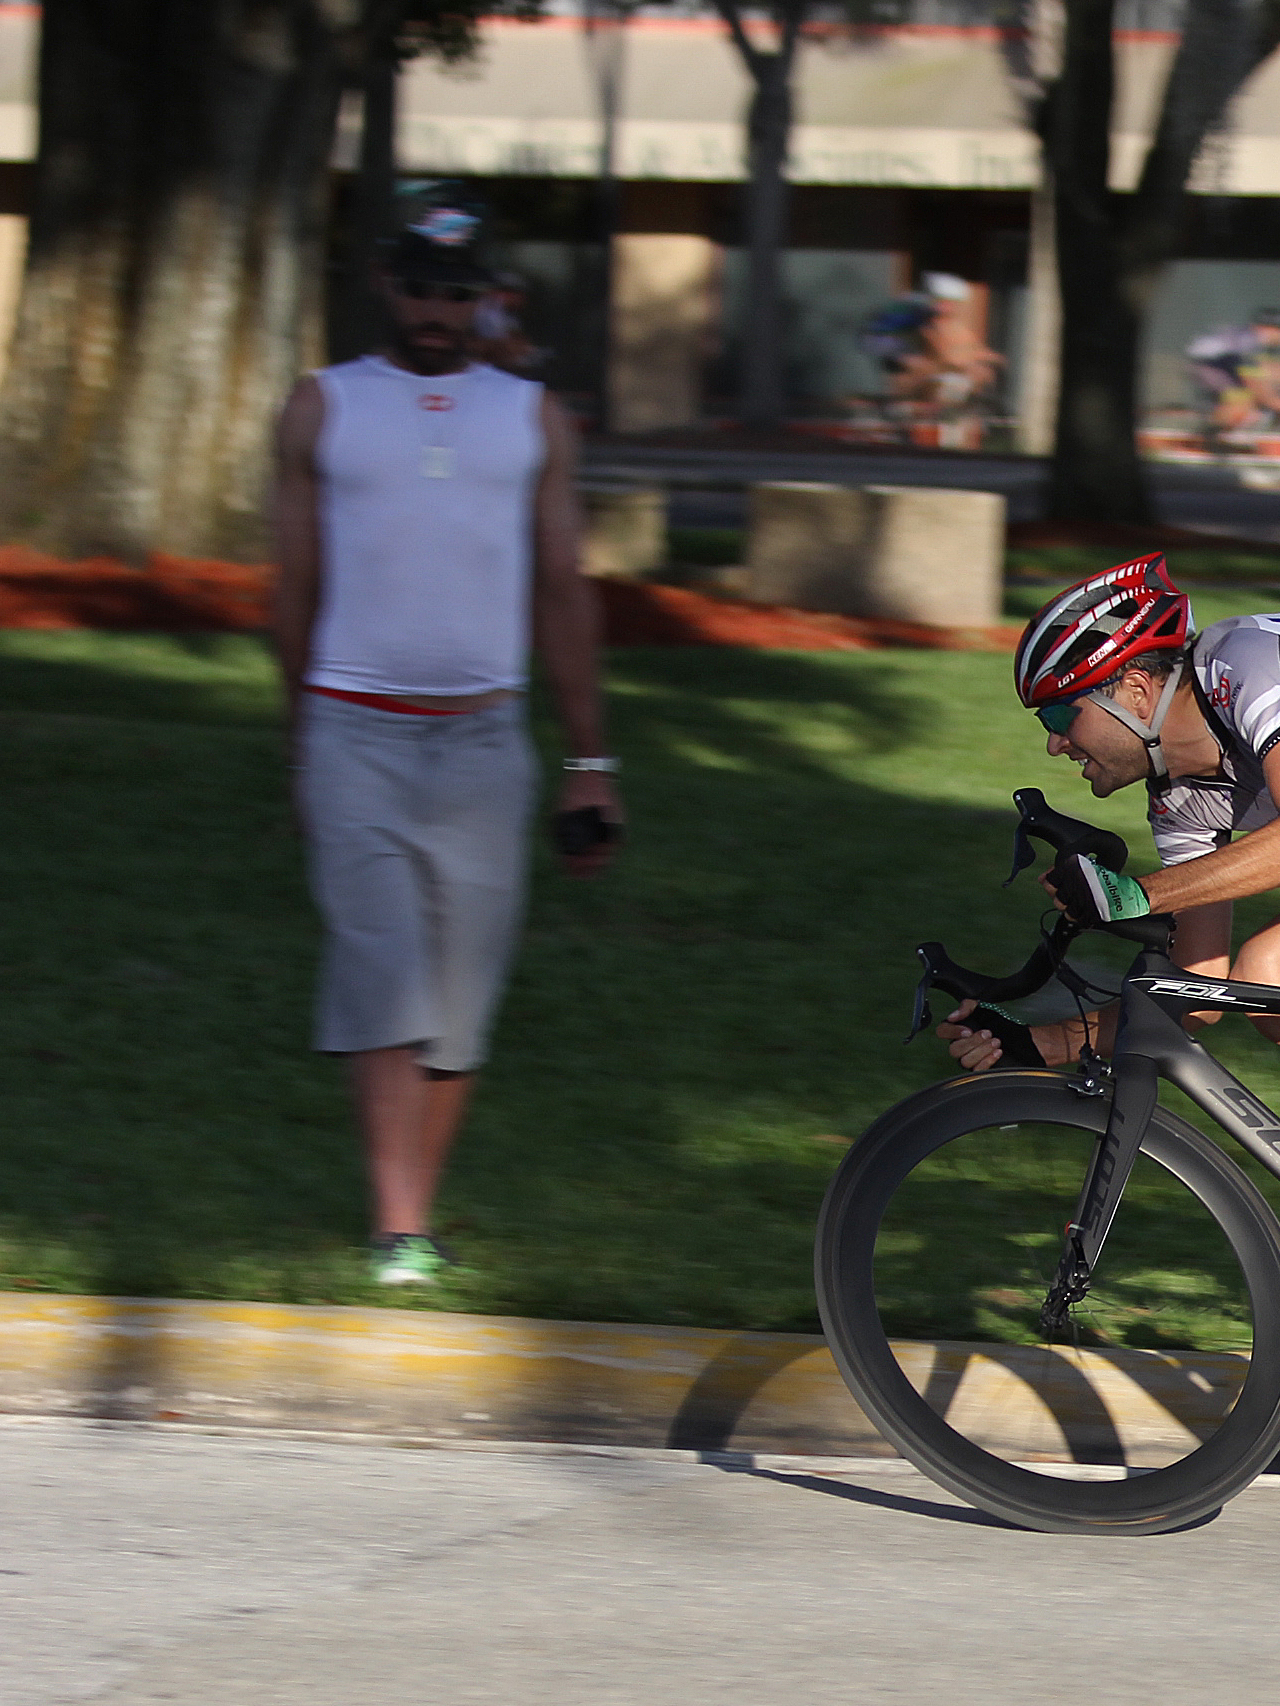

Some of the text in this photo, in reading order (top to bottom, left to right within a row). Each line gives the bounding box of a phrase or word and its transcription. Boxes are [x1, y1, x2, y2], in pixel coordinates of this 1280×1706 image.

[1125, 598, 1156, 633] GARNEAU
[1088, 640, 1116, 666] KEN
[1149, 980, 1237, 1001] FOIL
